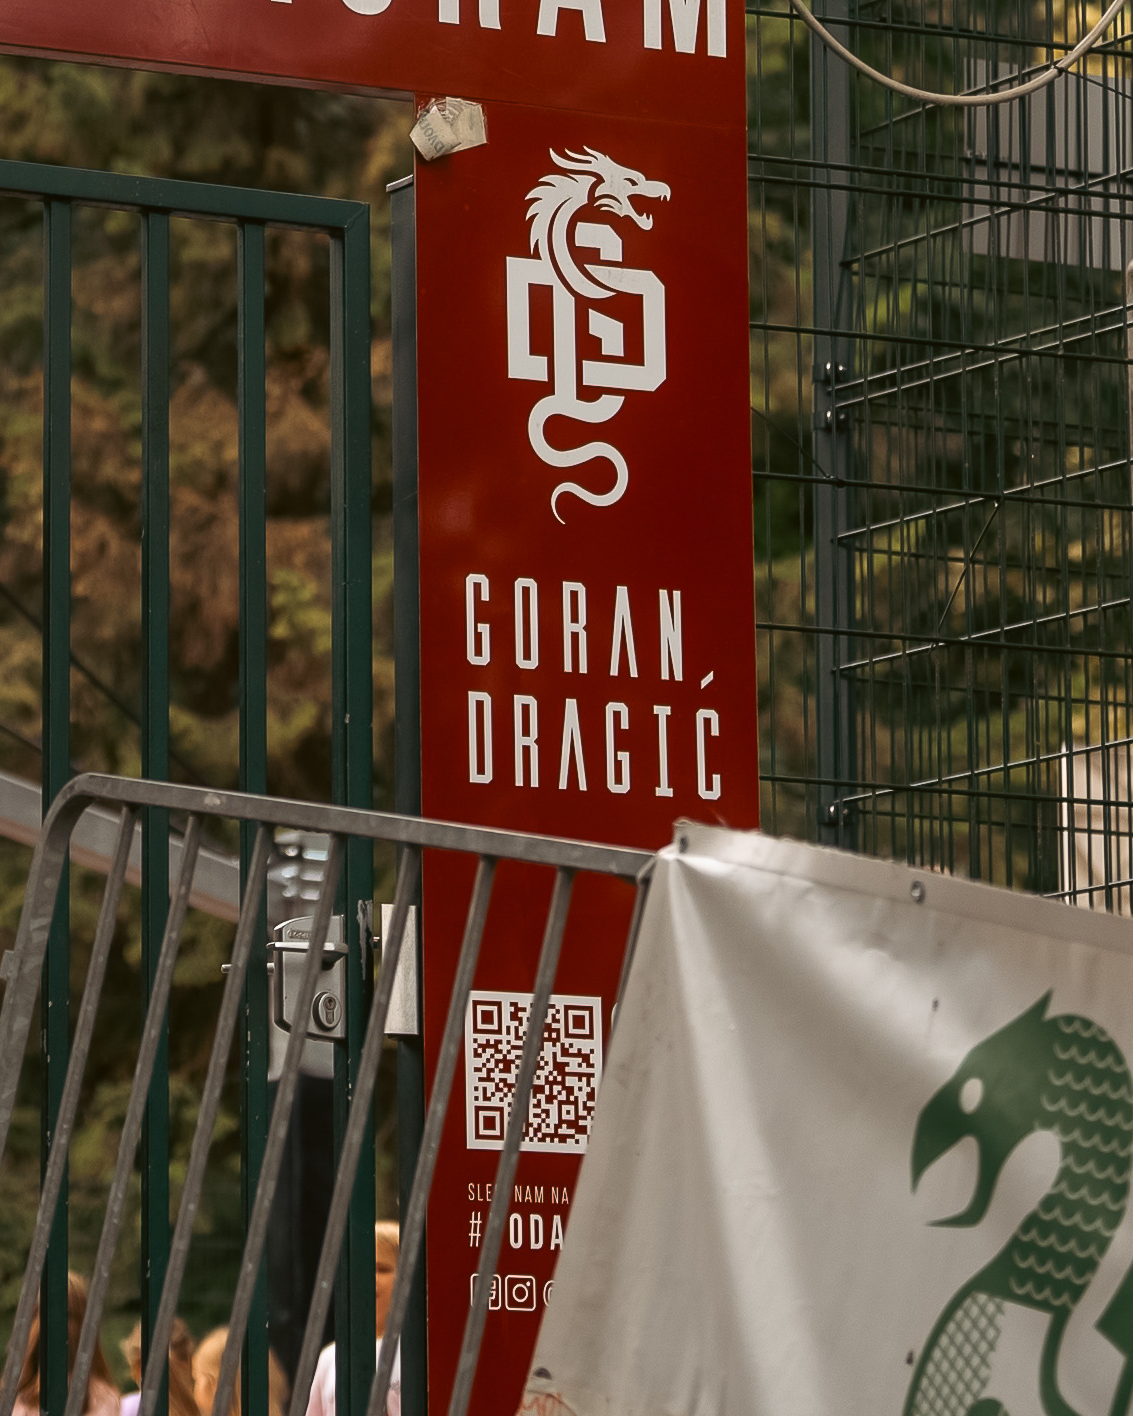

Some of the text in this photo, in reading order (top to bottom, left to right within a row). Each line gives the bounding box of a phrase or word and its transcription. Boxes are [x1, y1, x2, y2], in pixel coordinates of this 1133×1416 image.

[465, 573, 683, 682] GORAN
[468, 670, 721, 800] DRAGIĆ
[514, 1185, 544, 1204] NAM
